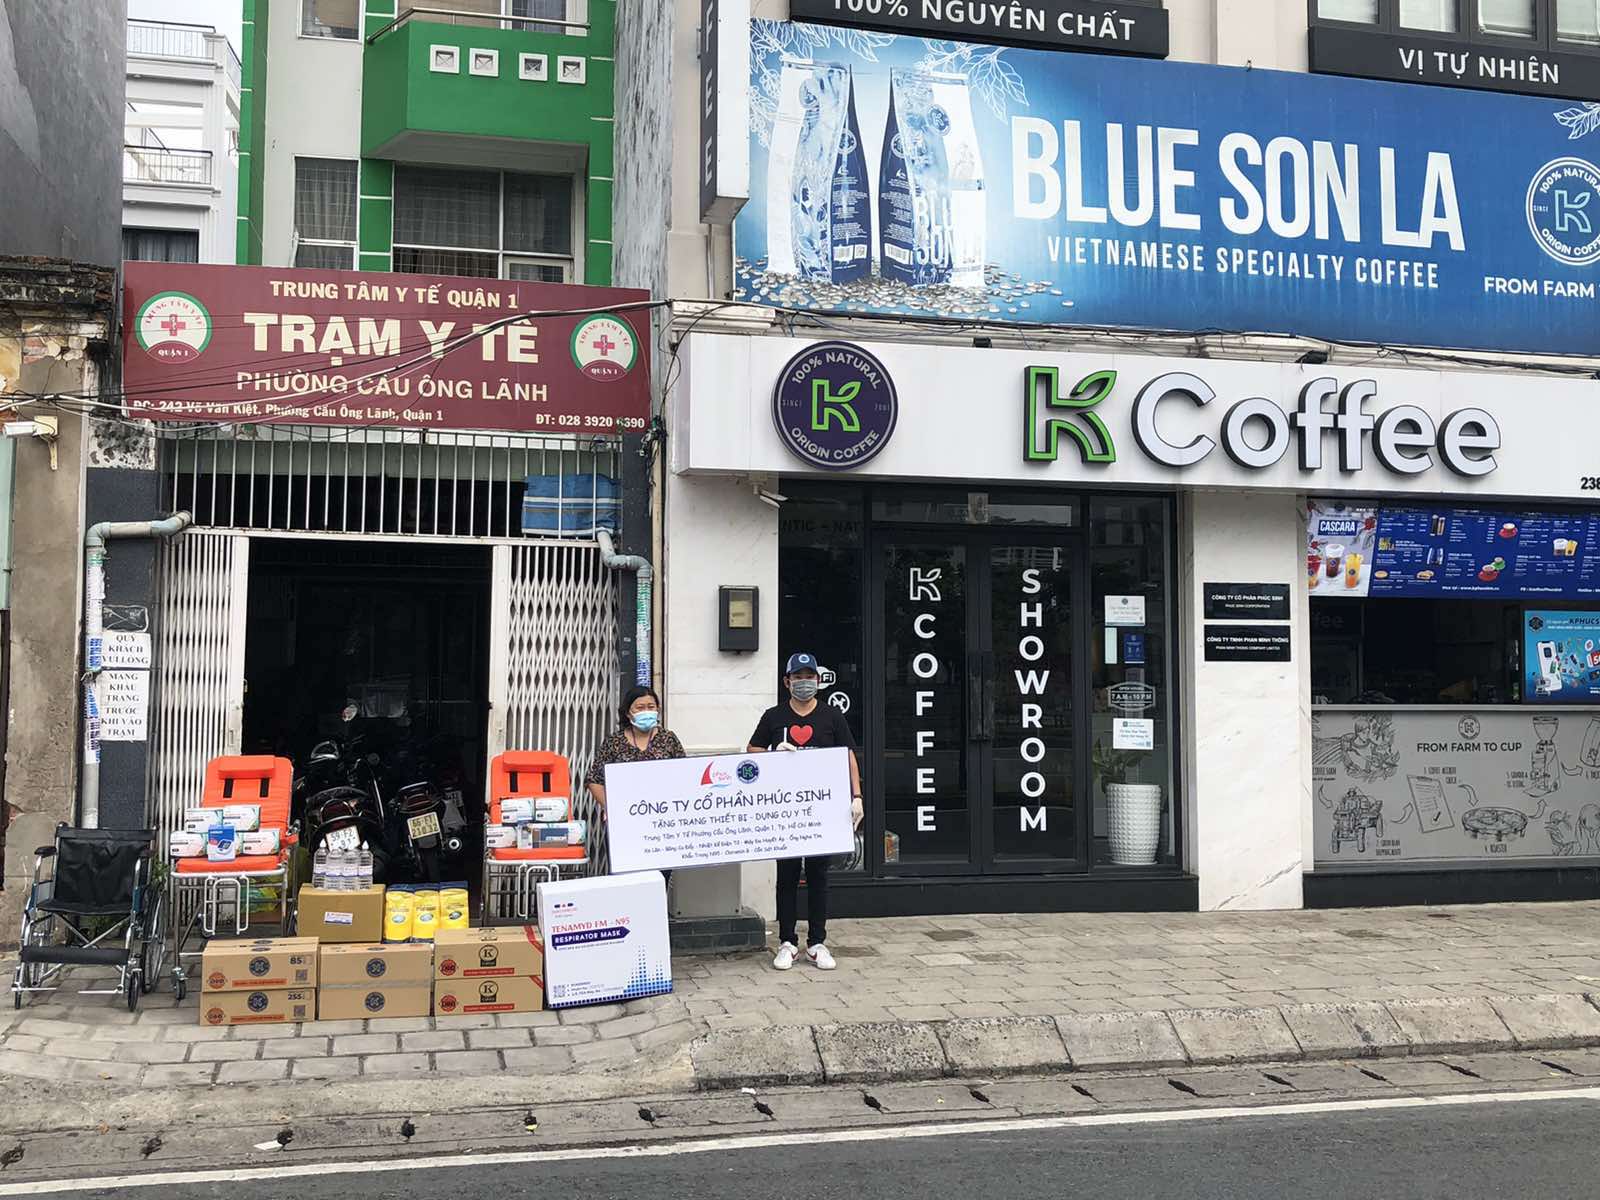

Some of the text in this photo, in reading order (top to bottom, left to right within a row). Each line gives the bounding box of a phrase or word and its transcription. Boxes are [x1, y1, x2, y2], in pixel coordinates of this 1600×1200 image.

[922, 0, 1045, 31] NGUYÊN
[1058, 10, 1136, 41] CHẤT
[1398, 47, 1561, 85] VỊ TỰ NHIÊN
[1011, 116, 1202, 231] BLUE
[1219, 132, 1361, 244] SON
[1379, 147, 1466, 252] LA
[1540, 171, 1562, 194] 100%
[1541, 228, 1572, 255] ORIGIN
[1047, 236, 1440, 290] VIETNAMESE SPECIALTY COFFEE
[270, 280, 518, 310] TRUNG TÂM Y TẾ QUẬN 1
[1484, 276, 1595, 299] FROM FARM
[243, 312, 401, 366] TRẠM
[418, 320, 457, 359] Y
[792, 351, 881, 390] 100% NATURAL
[236, 369, 349, 395] PHƯỜNG
[418, 374, 474, 399] ÔNG
[481, 378, 548, 402] LÃNH
[313, 403, 336, 418] Cầu
[340, 404, 363, 420] Ông
[366, 406, 399, 421] Lãnh,
[403, 408, 433, 422] Quận
[436, 410, 444, 421] 1
[535, 413, 556, 425] ĐT:
[558, 414, 581, 426] 028
[584, 416, 613, 427] 3920
[791, 427, 880, 460] ORIGIN COFFEE
[1320, 521, 1356, 532] CASCARA
[1014, 568, 1050, 832] SHOWROOM
[1416, 742, 1522, 752] FROM FARM TO CUP
[629, 788, 831, 816] CÔNG TY CỔ PHẦN PHÚC SINH
[679, 817, 707, 827] TRANG
[551, 922, 592, 934] TENAMYD
[595, 919, 608, 928] FM
[615, 916, 630, 926] N95
[554, 930, 621, 944] RESPIRATOR MASK
